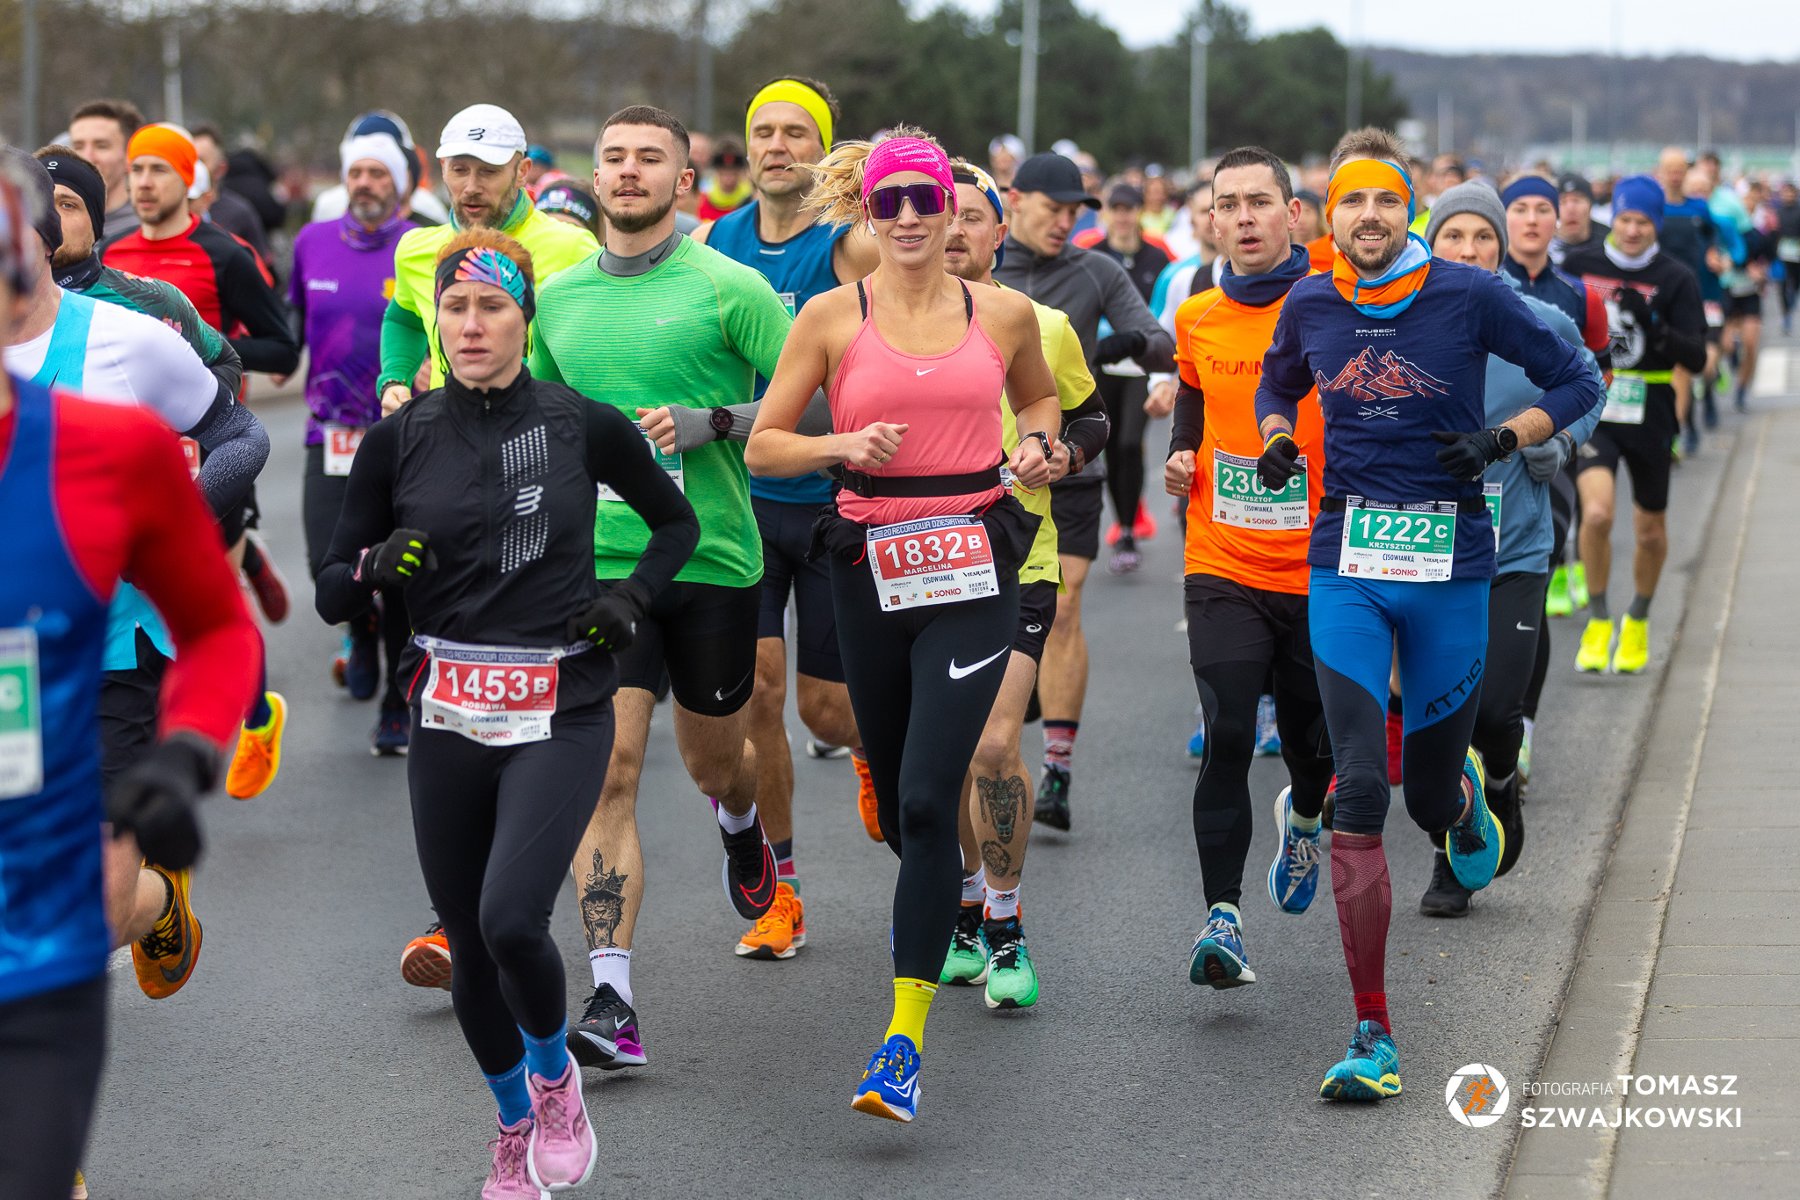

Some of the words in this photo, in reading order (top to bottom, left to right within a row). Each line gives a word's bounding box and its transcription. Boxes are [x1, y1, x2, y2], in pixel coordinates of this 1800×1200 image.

[1211, 360, 1263, 375] RUNN
[1222, 467, 1286, 496] 230
[1288, 476, 1301, 489] C
[1231, 493, 1273, 503] KRZYSZTOF
[1244, 504, 1273, 513] CISOWIANKA
[883, 528, 892, 537] 20
[892, 522, 931, 535] RECORDOWA
[1358, 513, 1432, 544] 1222
[1434, 524, 1448, 539] C
[884, 532, 966, 569] 1832
[966, 534, 983, 550] B
[1368, 541, 1416, 551] KRZYSZTOF
[1382, 553, 1414, 563] CISOWIANKA
[903, 562, 953, 576] MARCELINA
[1390, 568, 1418, 577] SONKO
[922, 573, 955, 585] CISOWIANKA
[934, 587, 962, 598] SONKO
[446, 666, 529, 702] 1453
[533, 677, 550, 694] B
[460, 700, 507, 711] DOBRAWA
[480, 730, 513, 740] SONKO
